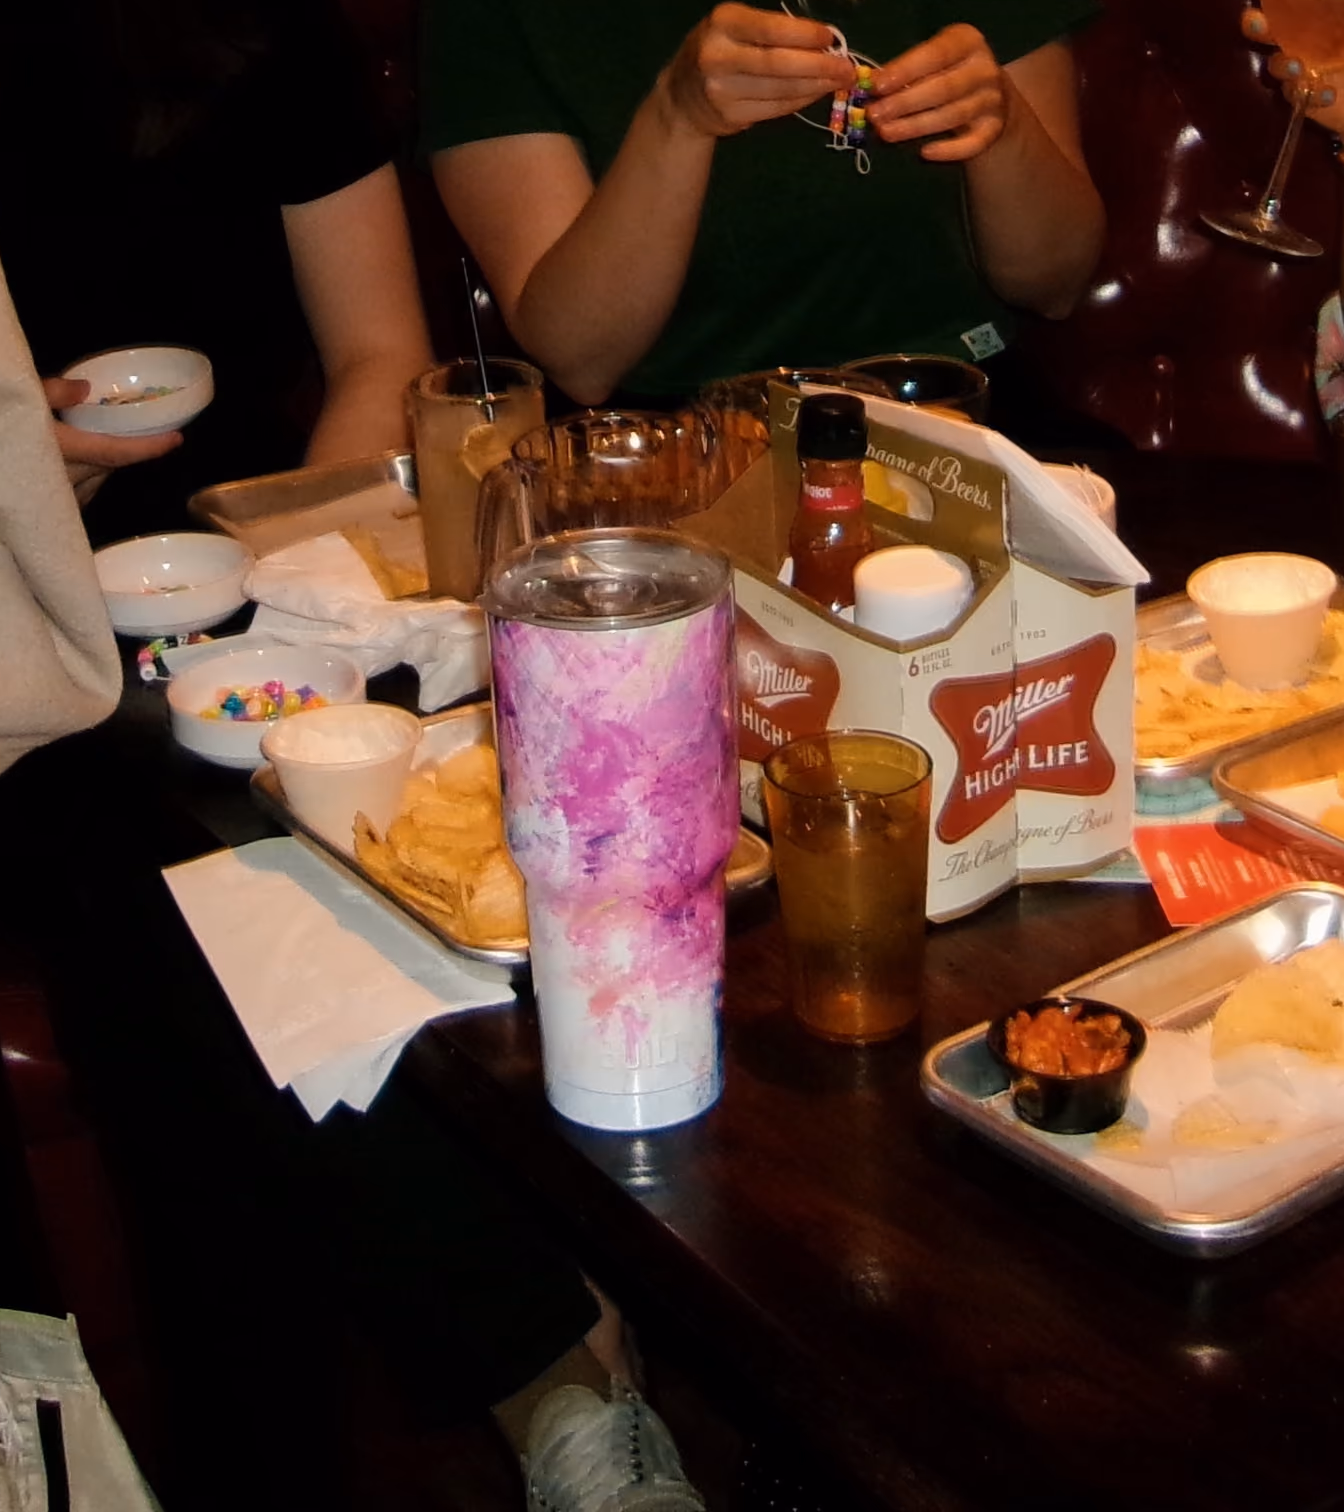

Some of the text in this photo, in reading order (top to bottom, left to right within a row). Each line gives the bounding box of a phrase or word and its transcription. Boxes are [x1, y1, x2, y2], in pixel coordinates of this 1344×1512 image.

[747, 650, 814, 695] Miller
[908, 656, 920, 677] 6
[741, 703, 783, 746] HIGH
[973, 673, 1074, 759] Miller
[965, 739, 1090, 800] HIGH LIFE
[938, 850, 971, 883] The
[1052, 813, 1075, 845] of
